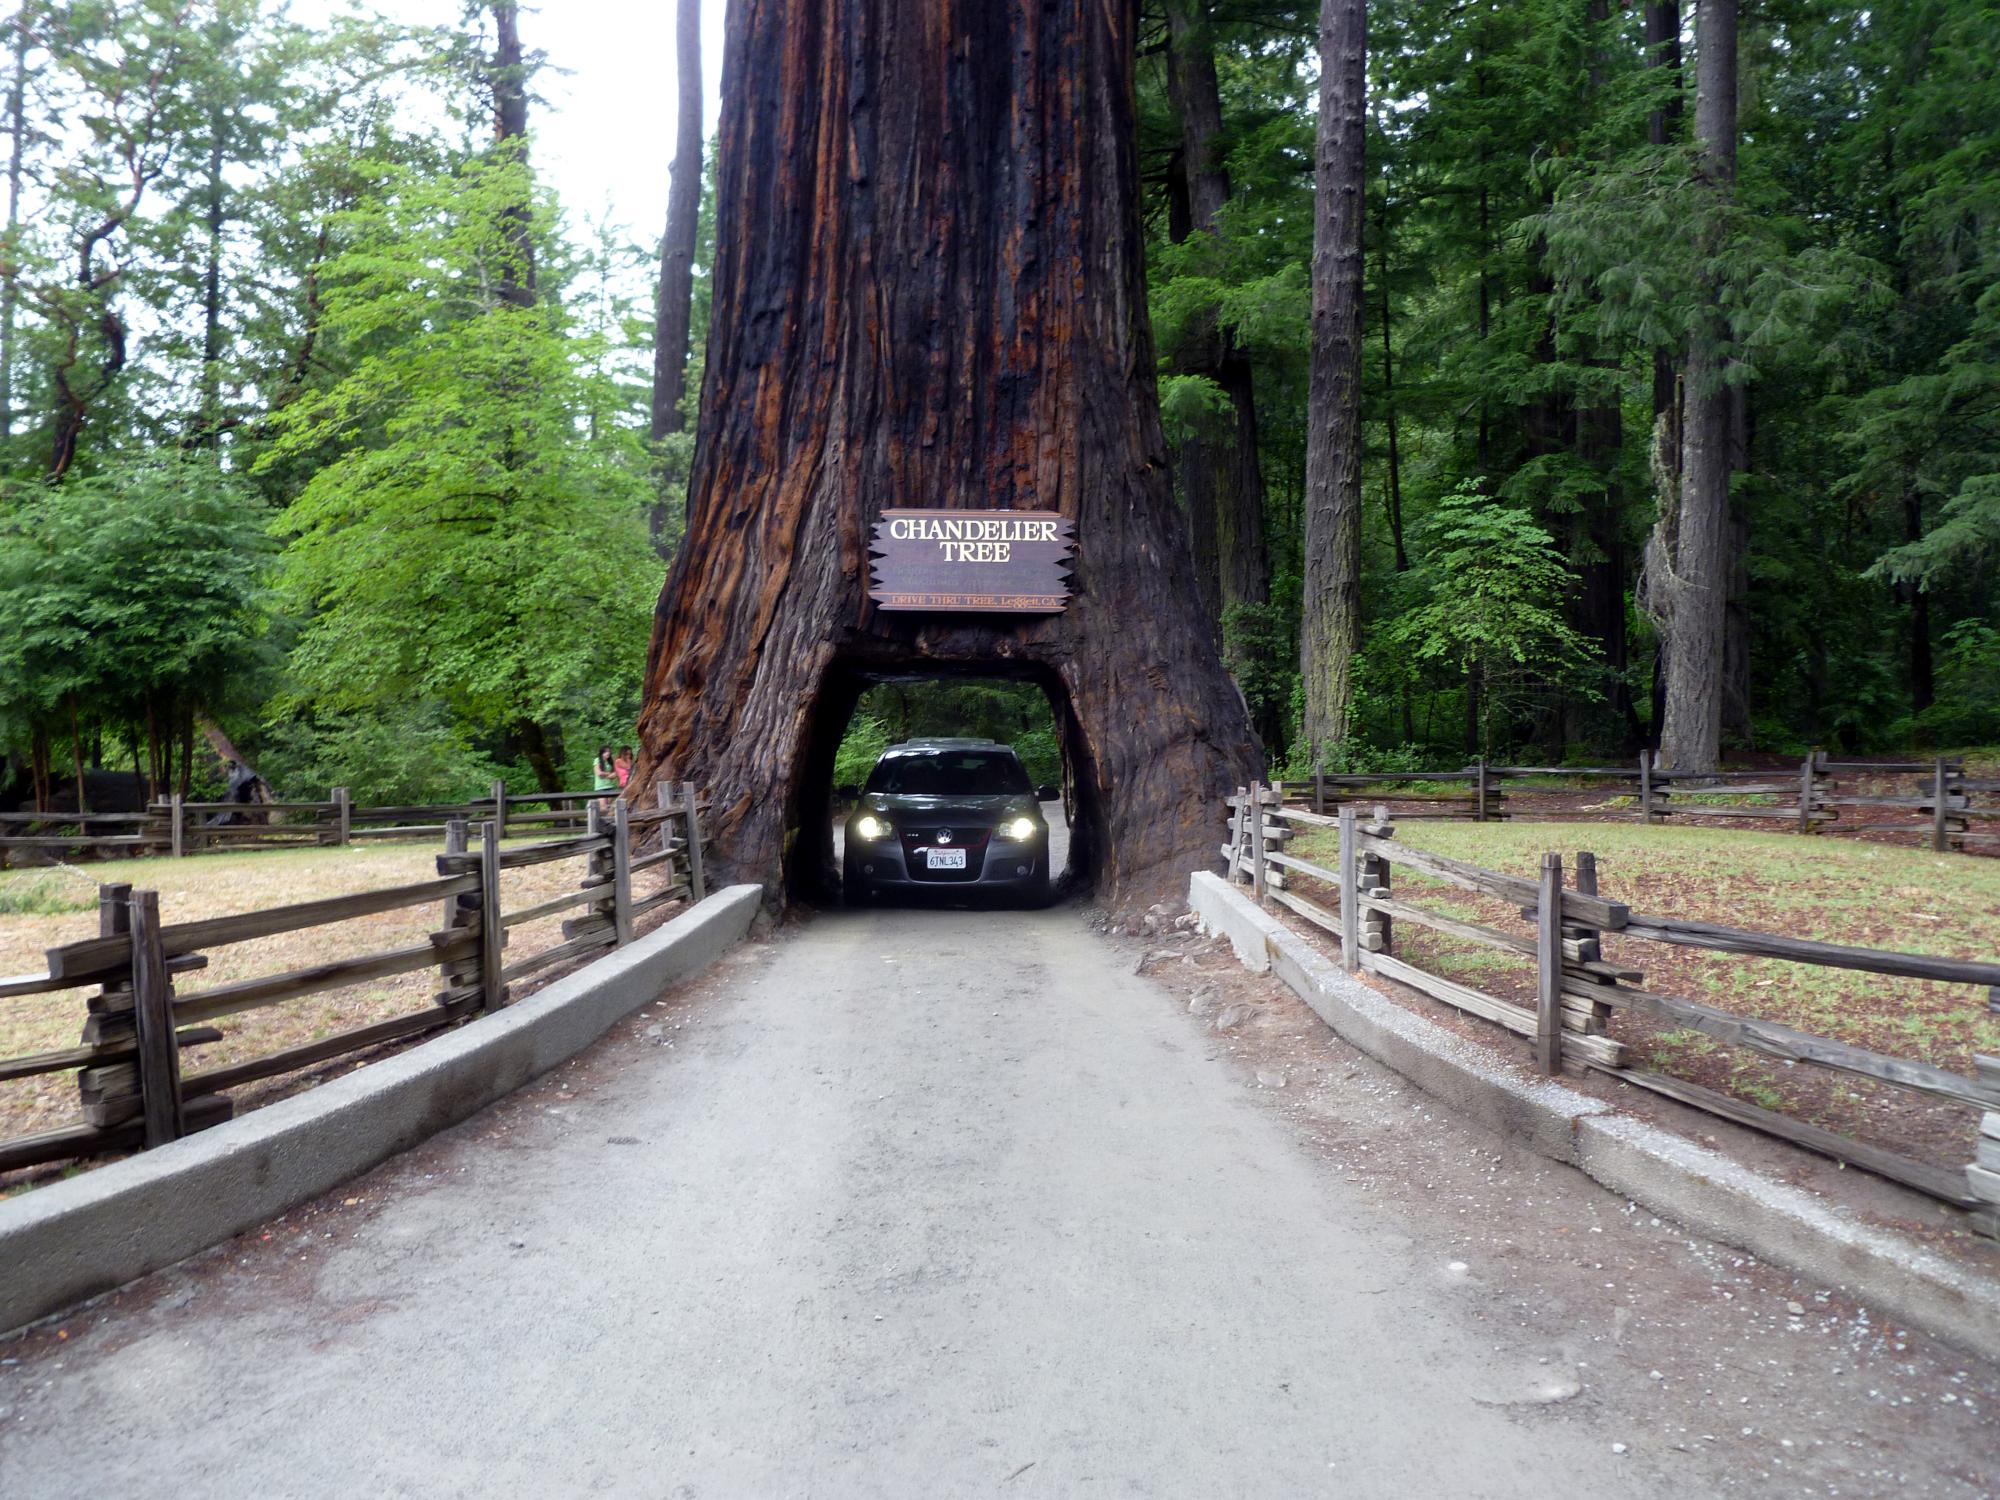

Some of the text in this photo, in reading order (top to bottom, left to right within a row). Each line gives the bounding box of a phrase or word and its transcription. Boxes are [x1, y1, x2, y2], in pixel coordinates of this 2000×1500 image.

[890, 519, 1058, 541] CHANDELIER
[939, 541, 1010, 562] TREE
[891, 595, 926, 605] DRIVE
[931, 596, 962, 605] THRU
